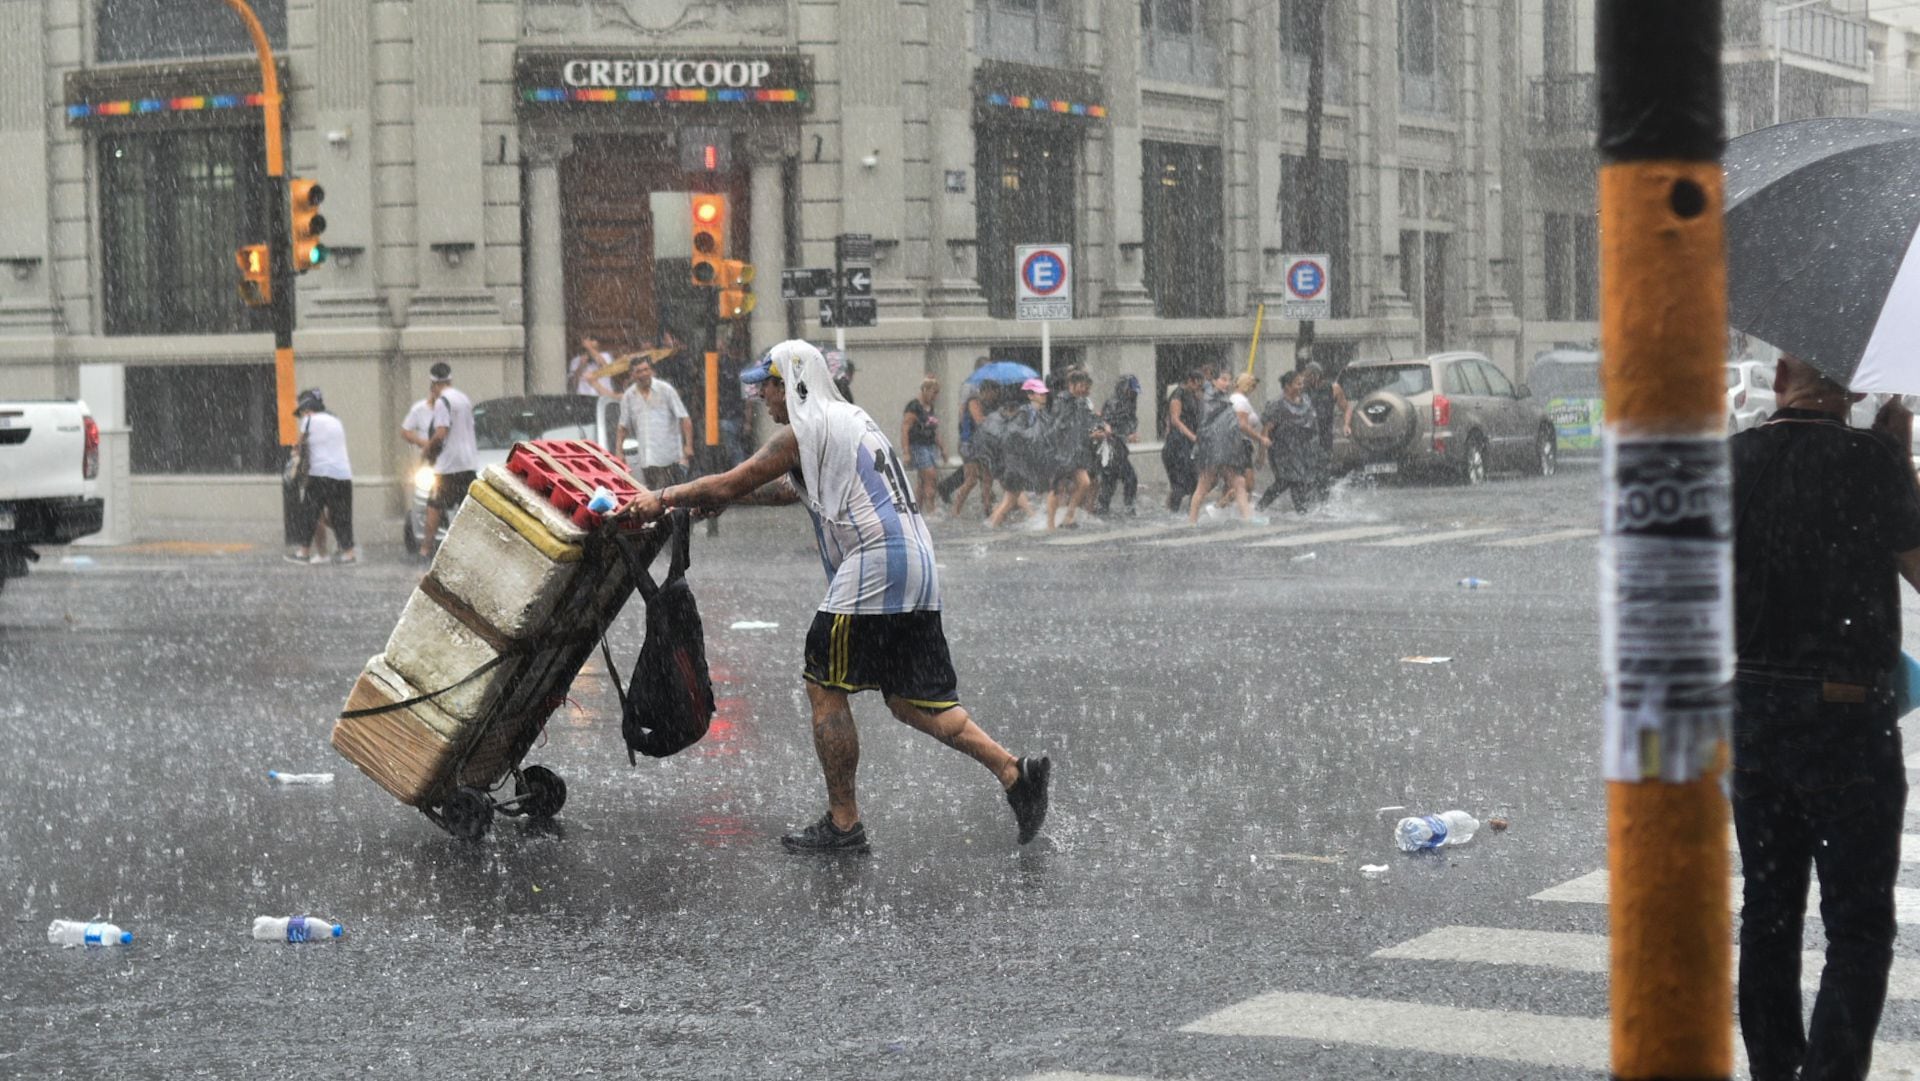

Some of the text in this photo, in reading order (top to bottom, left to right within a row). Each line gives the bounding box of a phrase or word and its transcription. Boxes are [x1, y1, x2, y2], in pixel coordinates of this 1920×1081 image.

[563, 59, 770, 87] CREDICOOP
[1033, 262, 1054, 287] E
[1297, 269, 1314, 290] E
